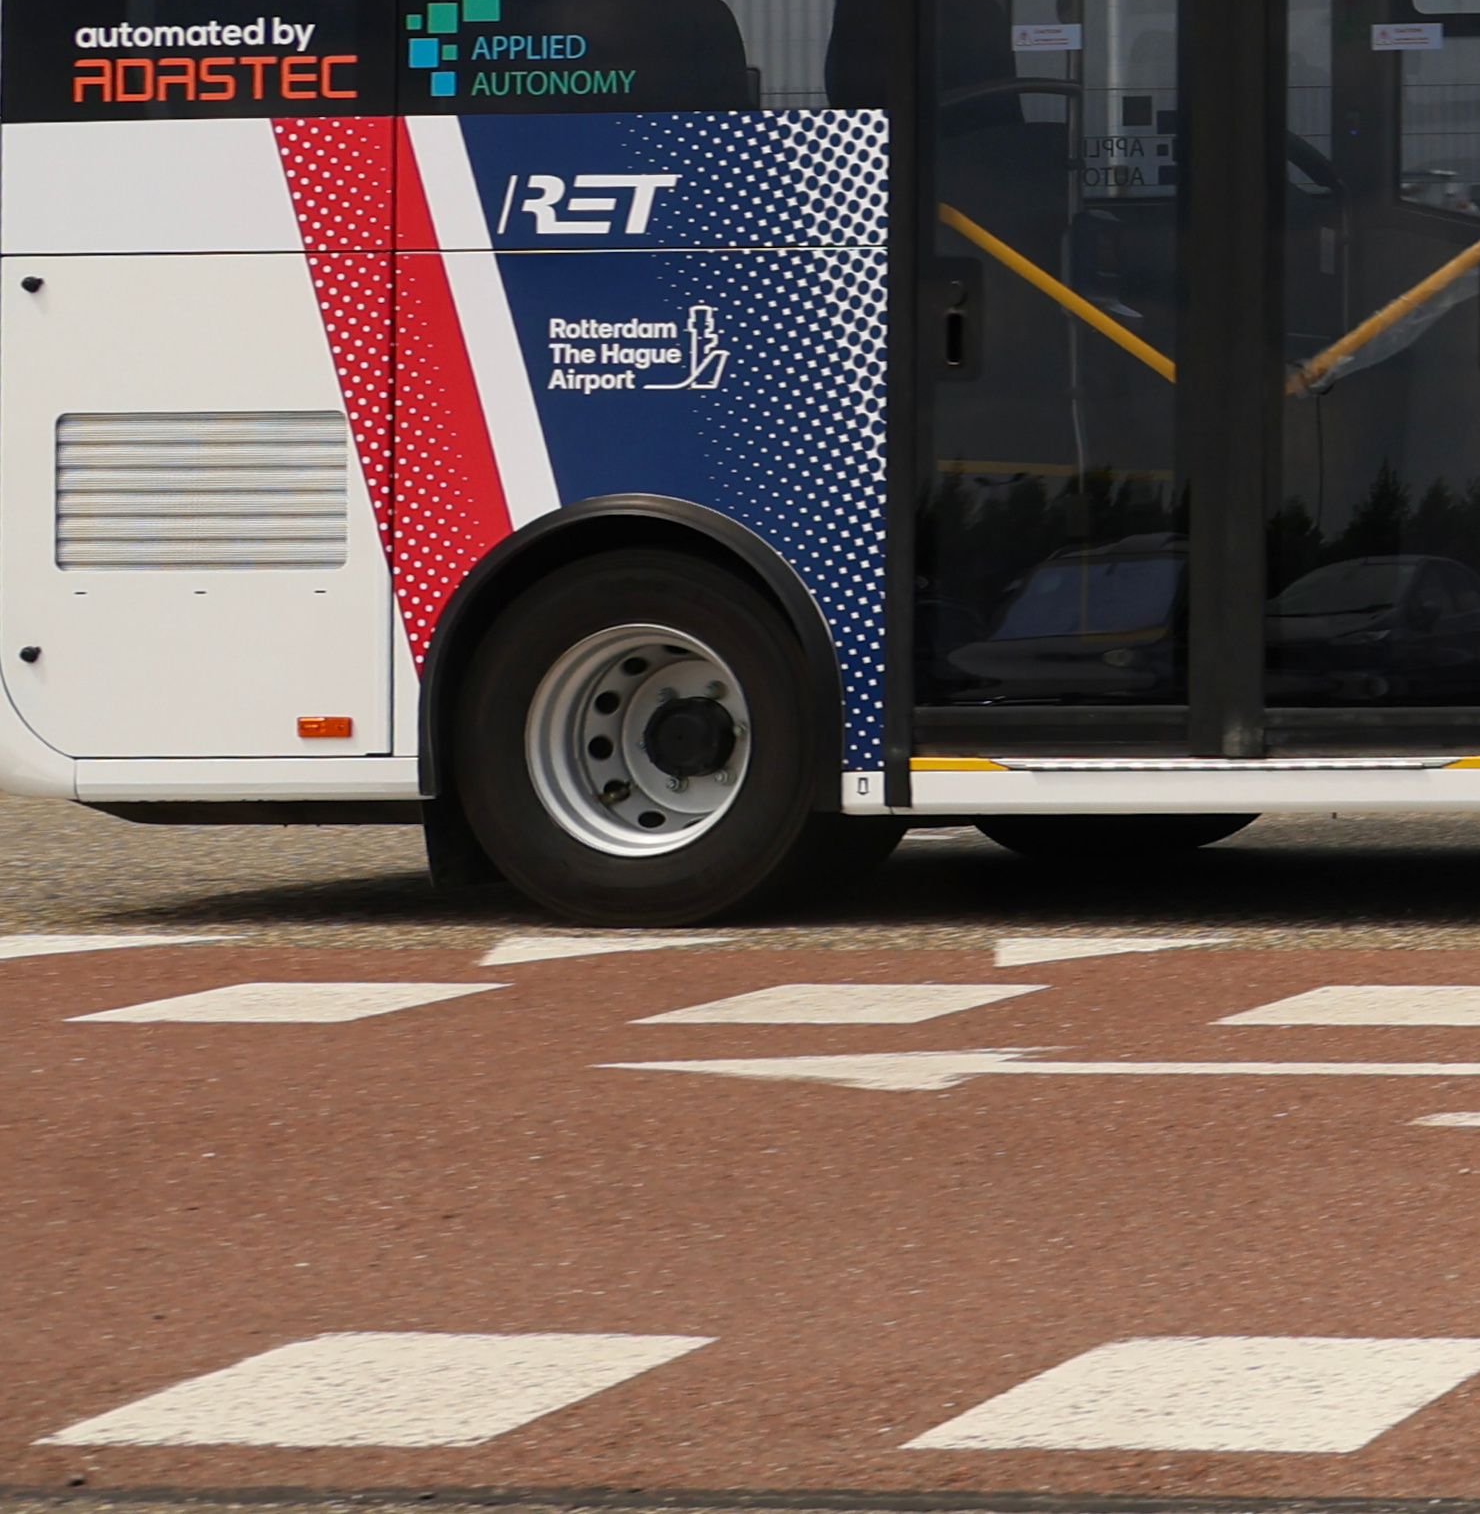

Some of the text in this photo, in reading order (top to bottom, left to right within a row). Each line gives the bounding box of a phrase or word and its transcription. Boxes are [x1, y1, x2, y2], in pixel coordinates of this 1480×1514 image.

[75, 16, 316, 53] automated by
[471, 34, 587, 61] APPLIED
[73, 54, 358, 103] ADASTEC
[471, 69, 637, 96] AUTONOMY
[497, 174, 679, 235] RET
[549, 318, 678, 339] Rotterdam
[548, 343, 682, 370] The Hague
[547, 368, 636, 395] Airport
